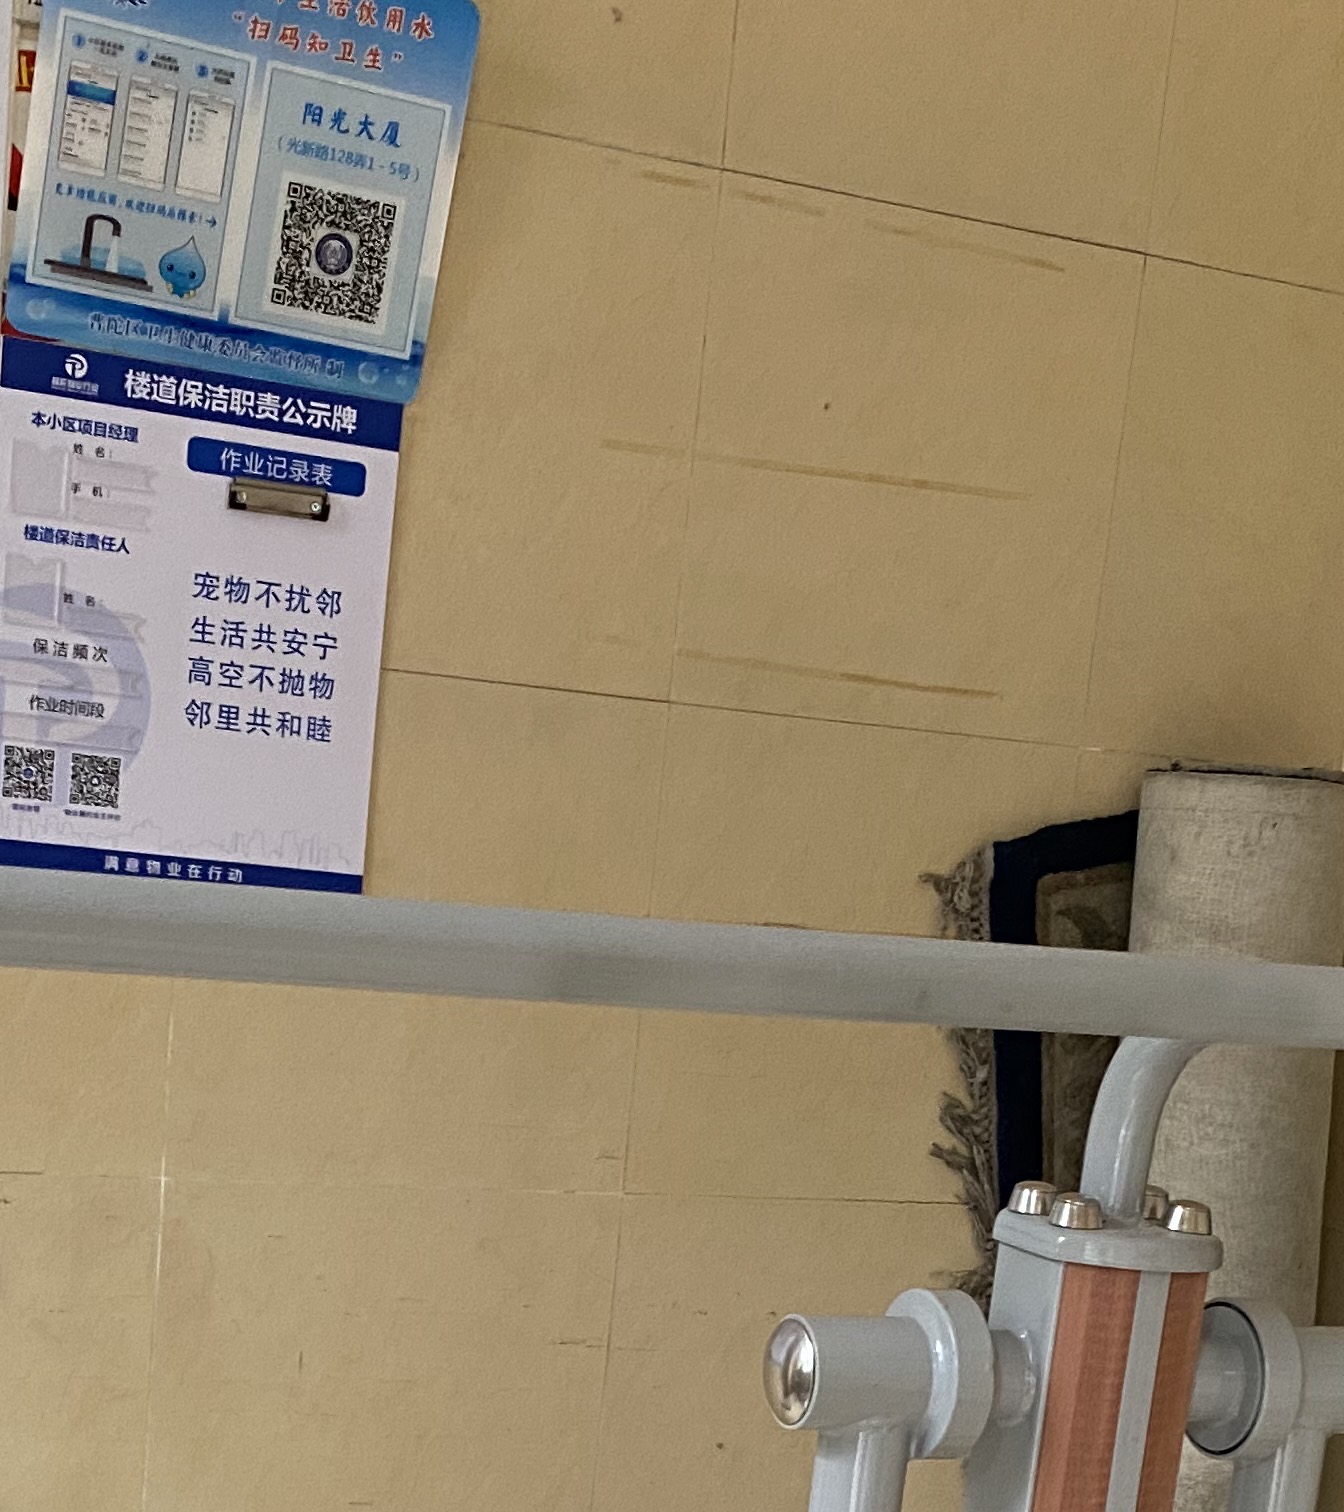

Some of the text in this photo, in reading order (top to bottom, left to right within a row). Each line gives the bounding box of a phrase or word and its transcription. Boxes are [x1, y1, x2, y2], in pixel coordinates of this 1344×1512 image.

[302, 102, 402, 149] 阳光大厦
[124, 368, 358, 435] 楼道保洁职责公示牌
[31, 410, 140, 443] 本小区项目经理
[219, 446, 333, 487] 作业记录表
[23, 523, 131, 555] 楼道保洁责任人
[192, 570, 343, 619] 宠物不扰邻
[32, 636, 109, 664] 保洁频次
[188, 615, 339, 661] 生活共安宁
[186, 655, 335, 700] 高空不抛物
[29, 693, 106, 729] 作业时间段
[184, 698, 333, 743] 邻里共和睦
